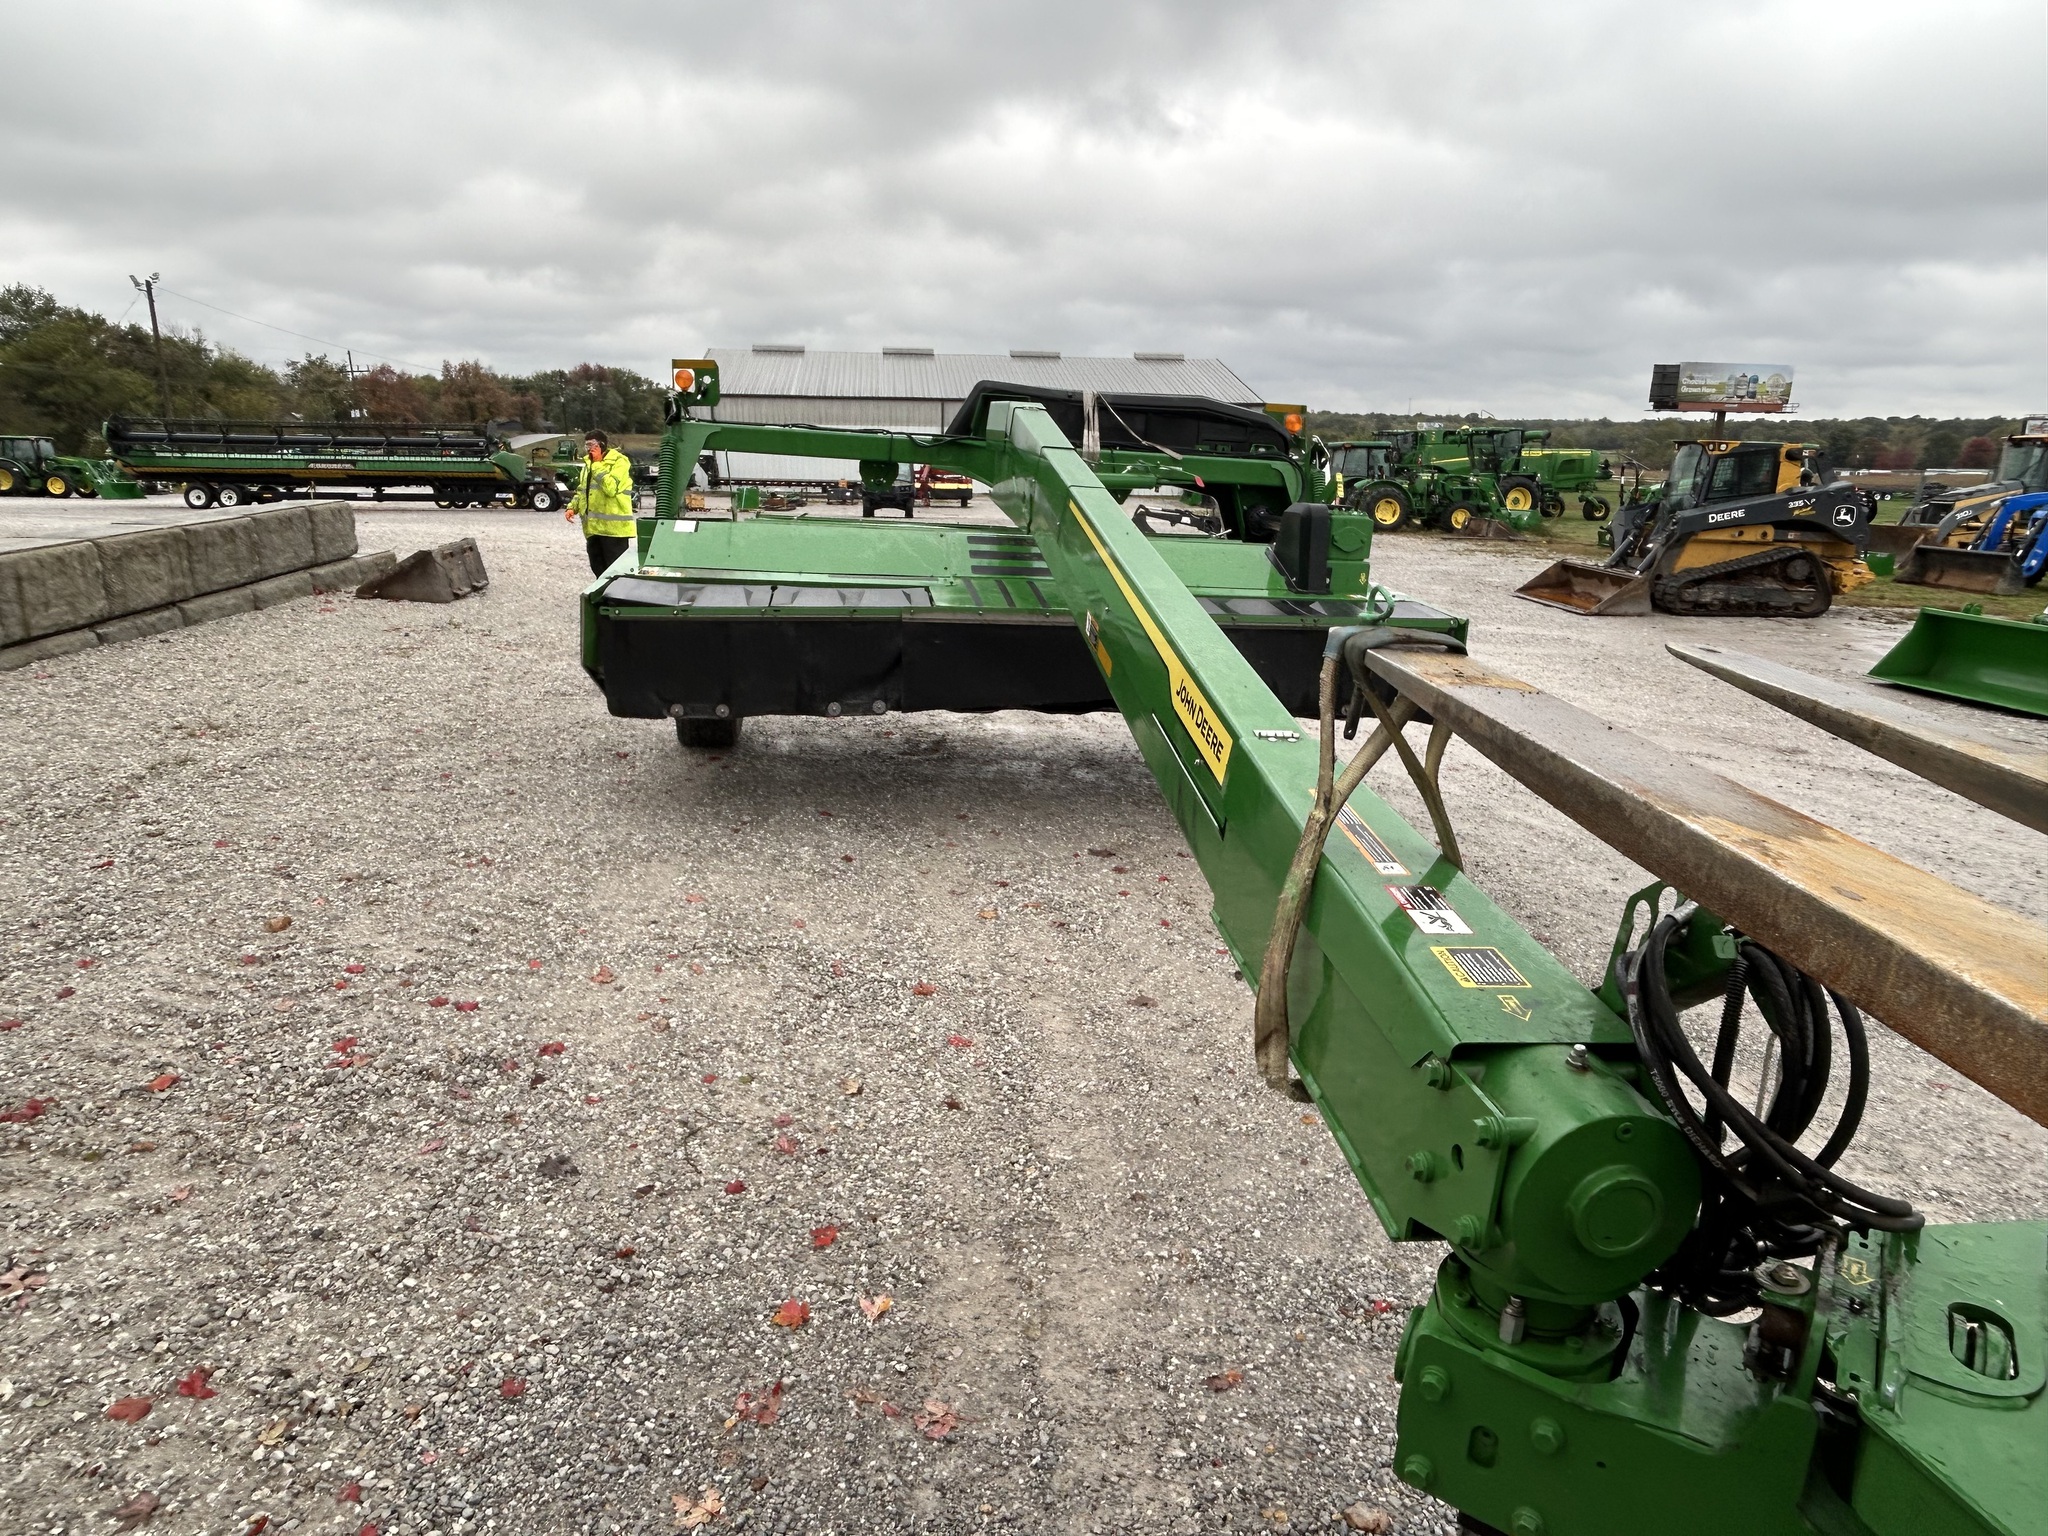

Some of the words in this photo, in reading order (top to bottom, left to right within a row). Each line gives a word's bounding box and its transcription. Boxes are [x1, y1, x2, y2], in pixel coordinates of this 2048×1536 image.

[1708, 509, 1746, 523] DEERE
[1176, 678, 1197, 720] JOHN
[1195, 704, 1224, 763] DEERE
[1650, 1068, 1669, 1097] T3000
[1683, 1126, 1722, 1168] DIEHARD
